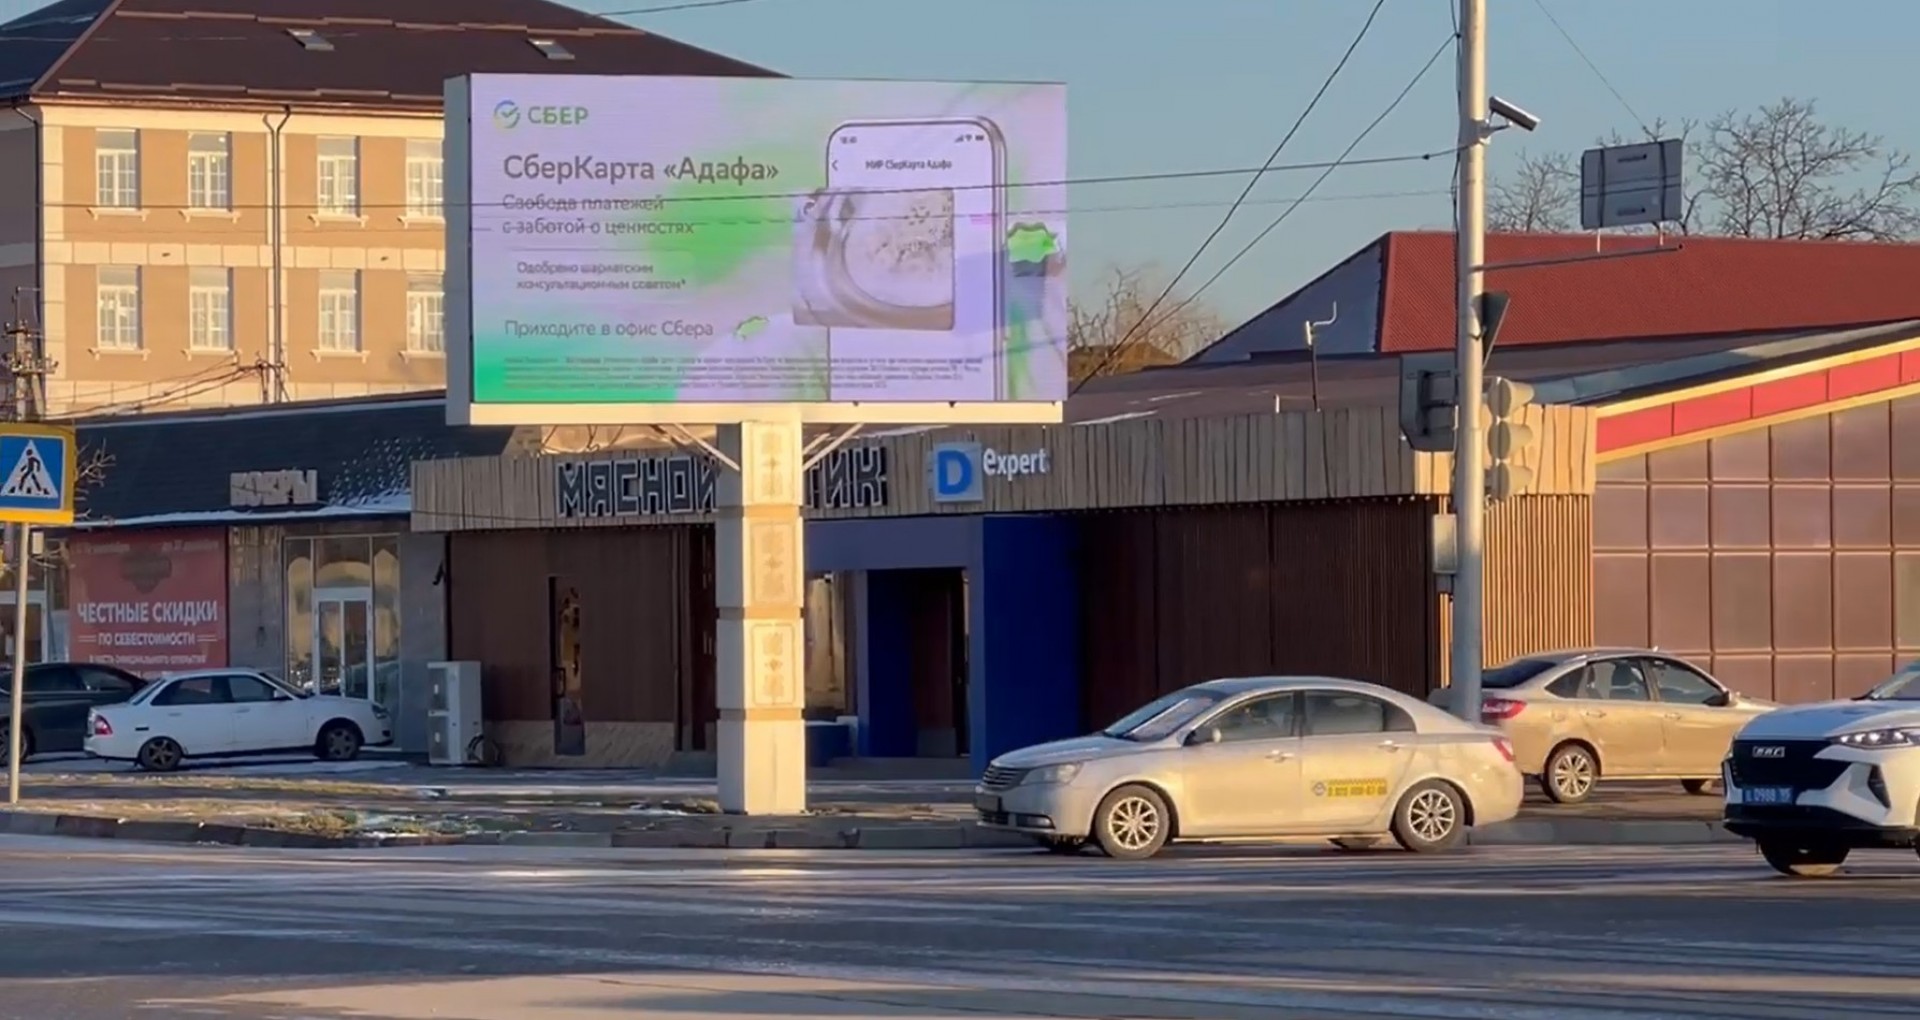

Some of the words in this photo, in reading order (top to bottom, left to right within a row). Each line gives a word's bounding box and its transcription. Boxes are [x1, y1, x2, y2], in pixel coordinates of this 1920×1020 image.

[527, 105, 589, 125] СБЕР
[503, 153, 655, 185] СберКарта
[663, 155, 779, 186] «Адафа»
[502, 194, 577, 212] Свобода
[581, 195, 664, 211] платежей
[502, 221, 512, 234] с
[517, 217, 585, 235] заботой
[590, 221, 600, 234] о
[604, 221, 694, 236] ценностях
[517, 262, 578, 275] Одобрено
[504, 320, 596, 338] Приходите
[601, 324, 610, 336] в
[616, 321, 656, 338] офис
[661, 320, 714, 338] Сбера
[938, 450, 972, 495] D
[556, 454, 719, 518] МЯСНОЙ
[802, 447, 883, 508] ТИК
[77, 602, 149, 623] ЧЕСТНЫЕ
[152, 601, 218, 625] СКИДКИ
[98, 633, 112, 645] ПО
[114, 632, 196, 646] СЕБЕСТОИМОСТИ
